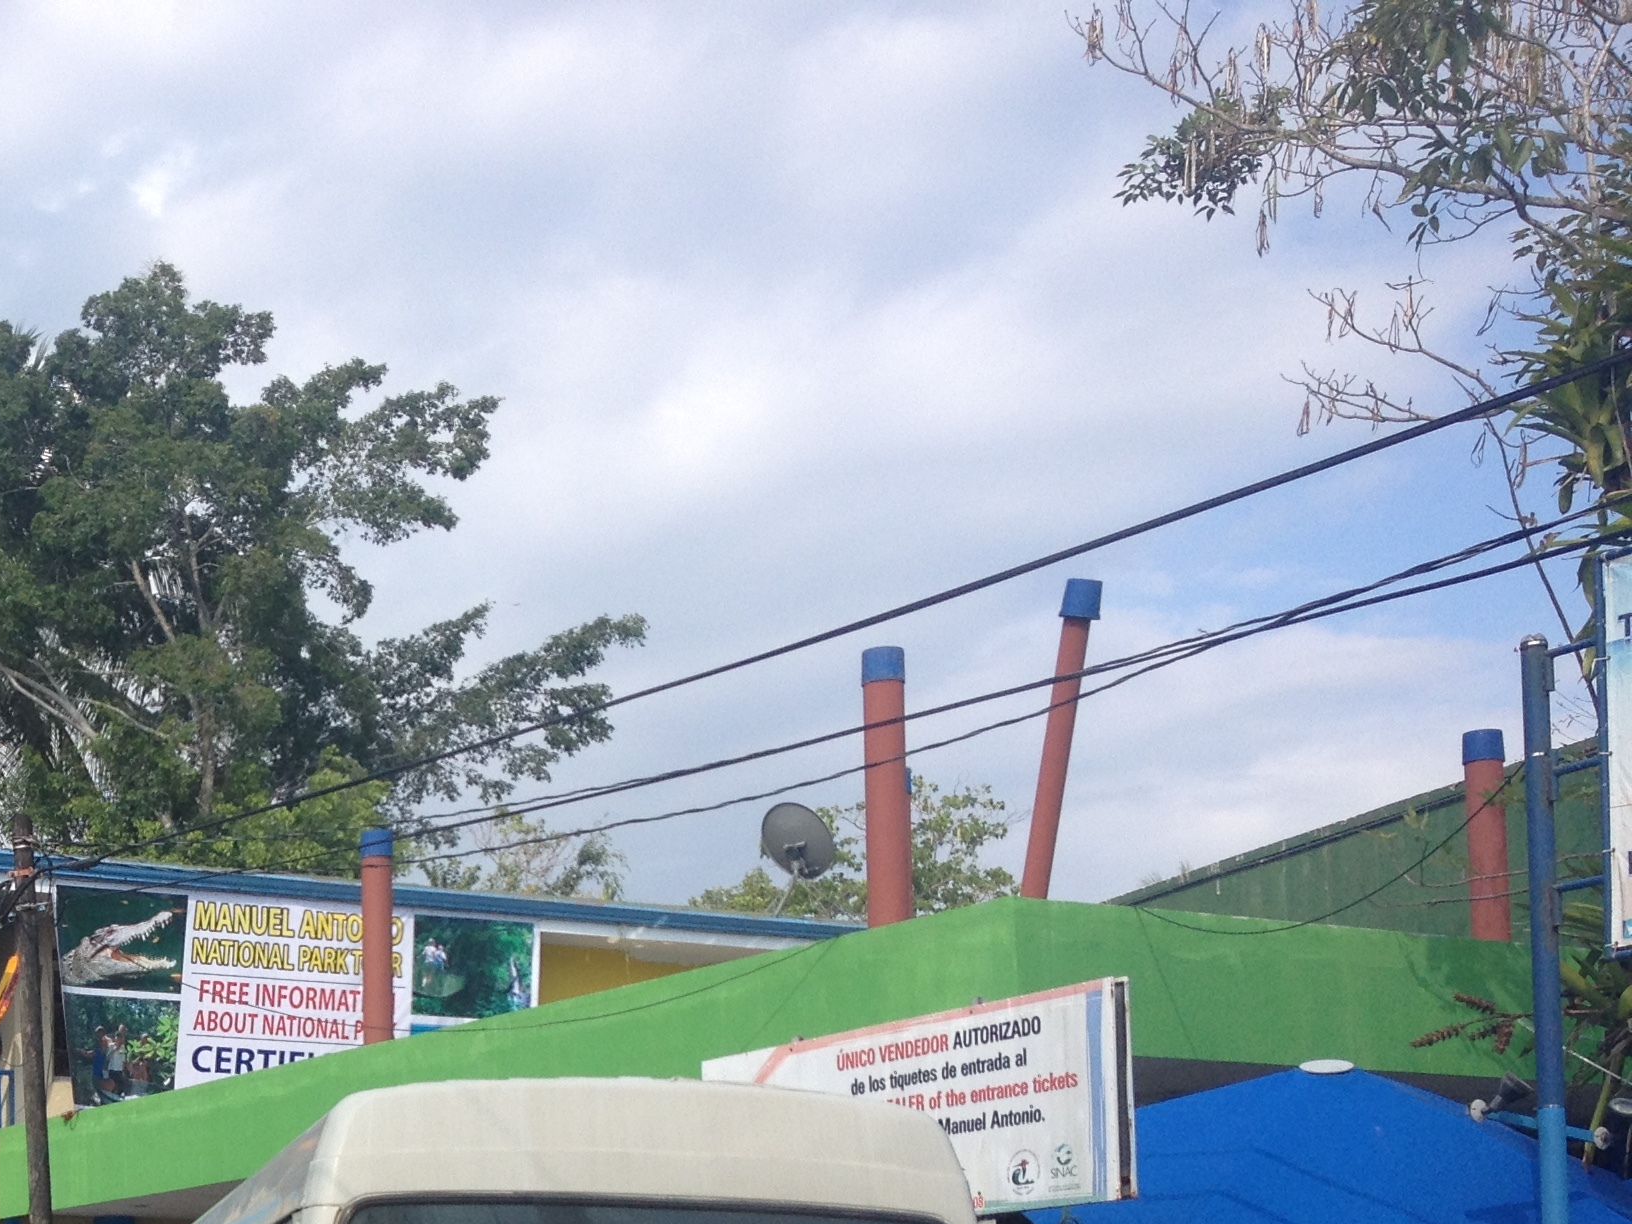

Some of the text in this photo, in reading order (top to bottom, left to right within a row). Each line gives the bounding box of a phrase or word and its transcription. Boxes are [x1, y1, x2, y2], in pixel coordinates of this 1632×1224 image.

[193, 901, 404, 946] MANUEL ANTOO
[191, 937, 403, 978] NATIONAL PARK TR
[199, 979, 367, 1013] FREE INFORMAT
[193, 1009, 258, 1035] ABOUT
[262, 1014, 349, 1041] NATIONAL
[836, 1016, 1041, 1071] ÚNICO VENDEDOR AUTORIZADO
[851, 1048, 1027, 1096] de los tiquetes de entrada al
[929, 1090, 942, 1110] of
[945, 1089, 966, 1108] the
[971, 1081, 1028, 1103] entrance
[1033, 1072, 1078, 1093] tickets
[990, 1105, 1045, 1130] Antonio.
